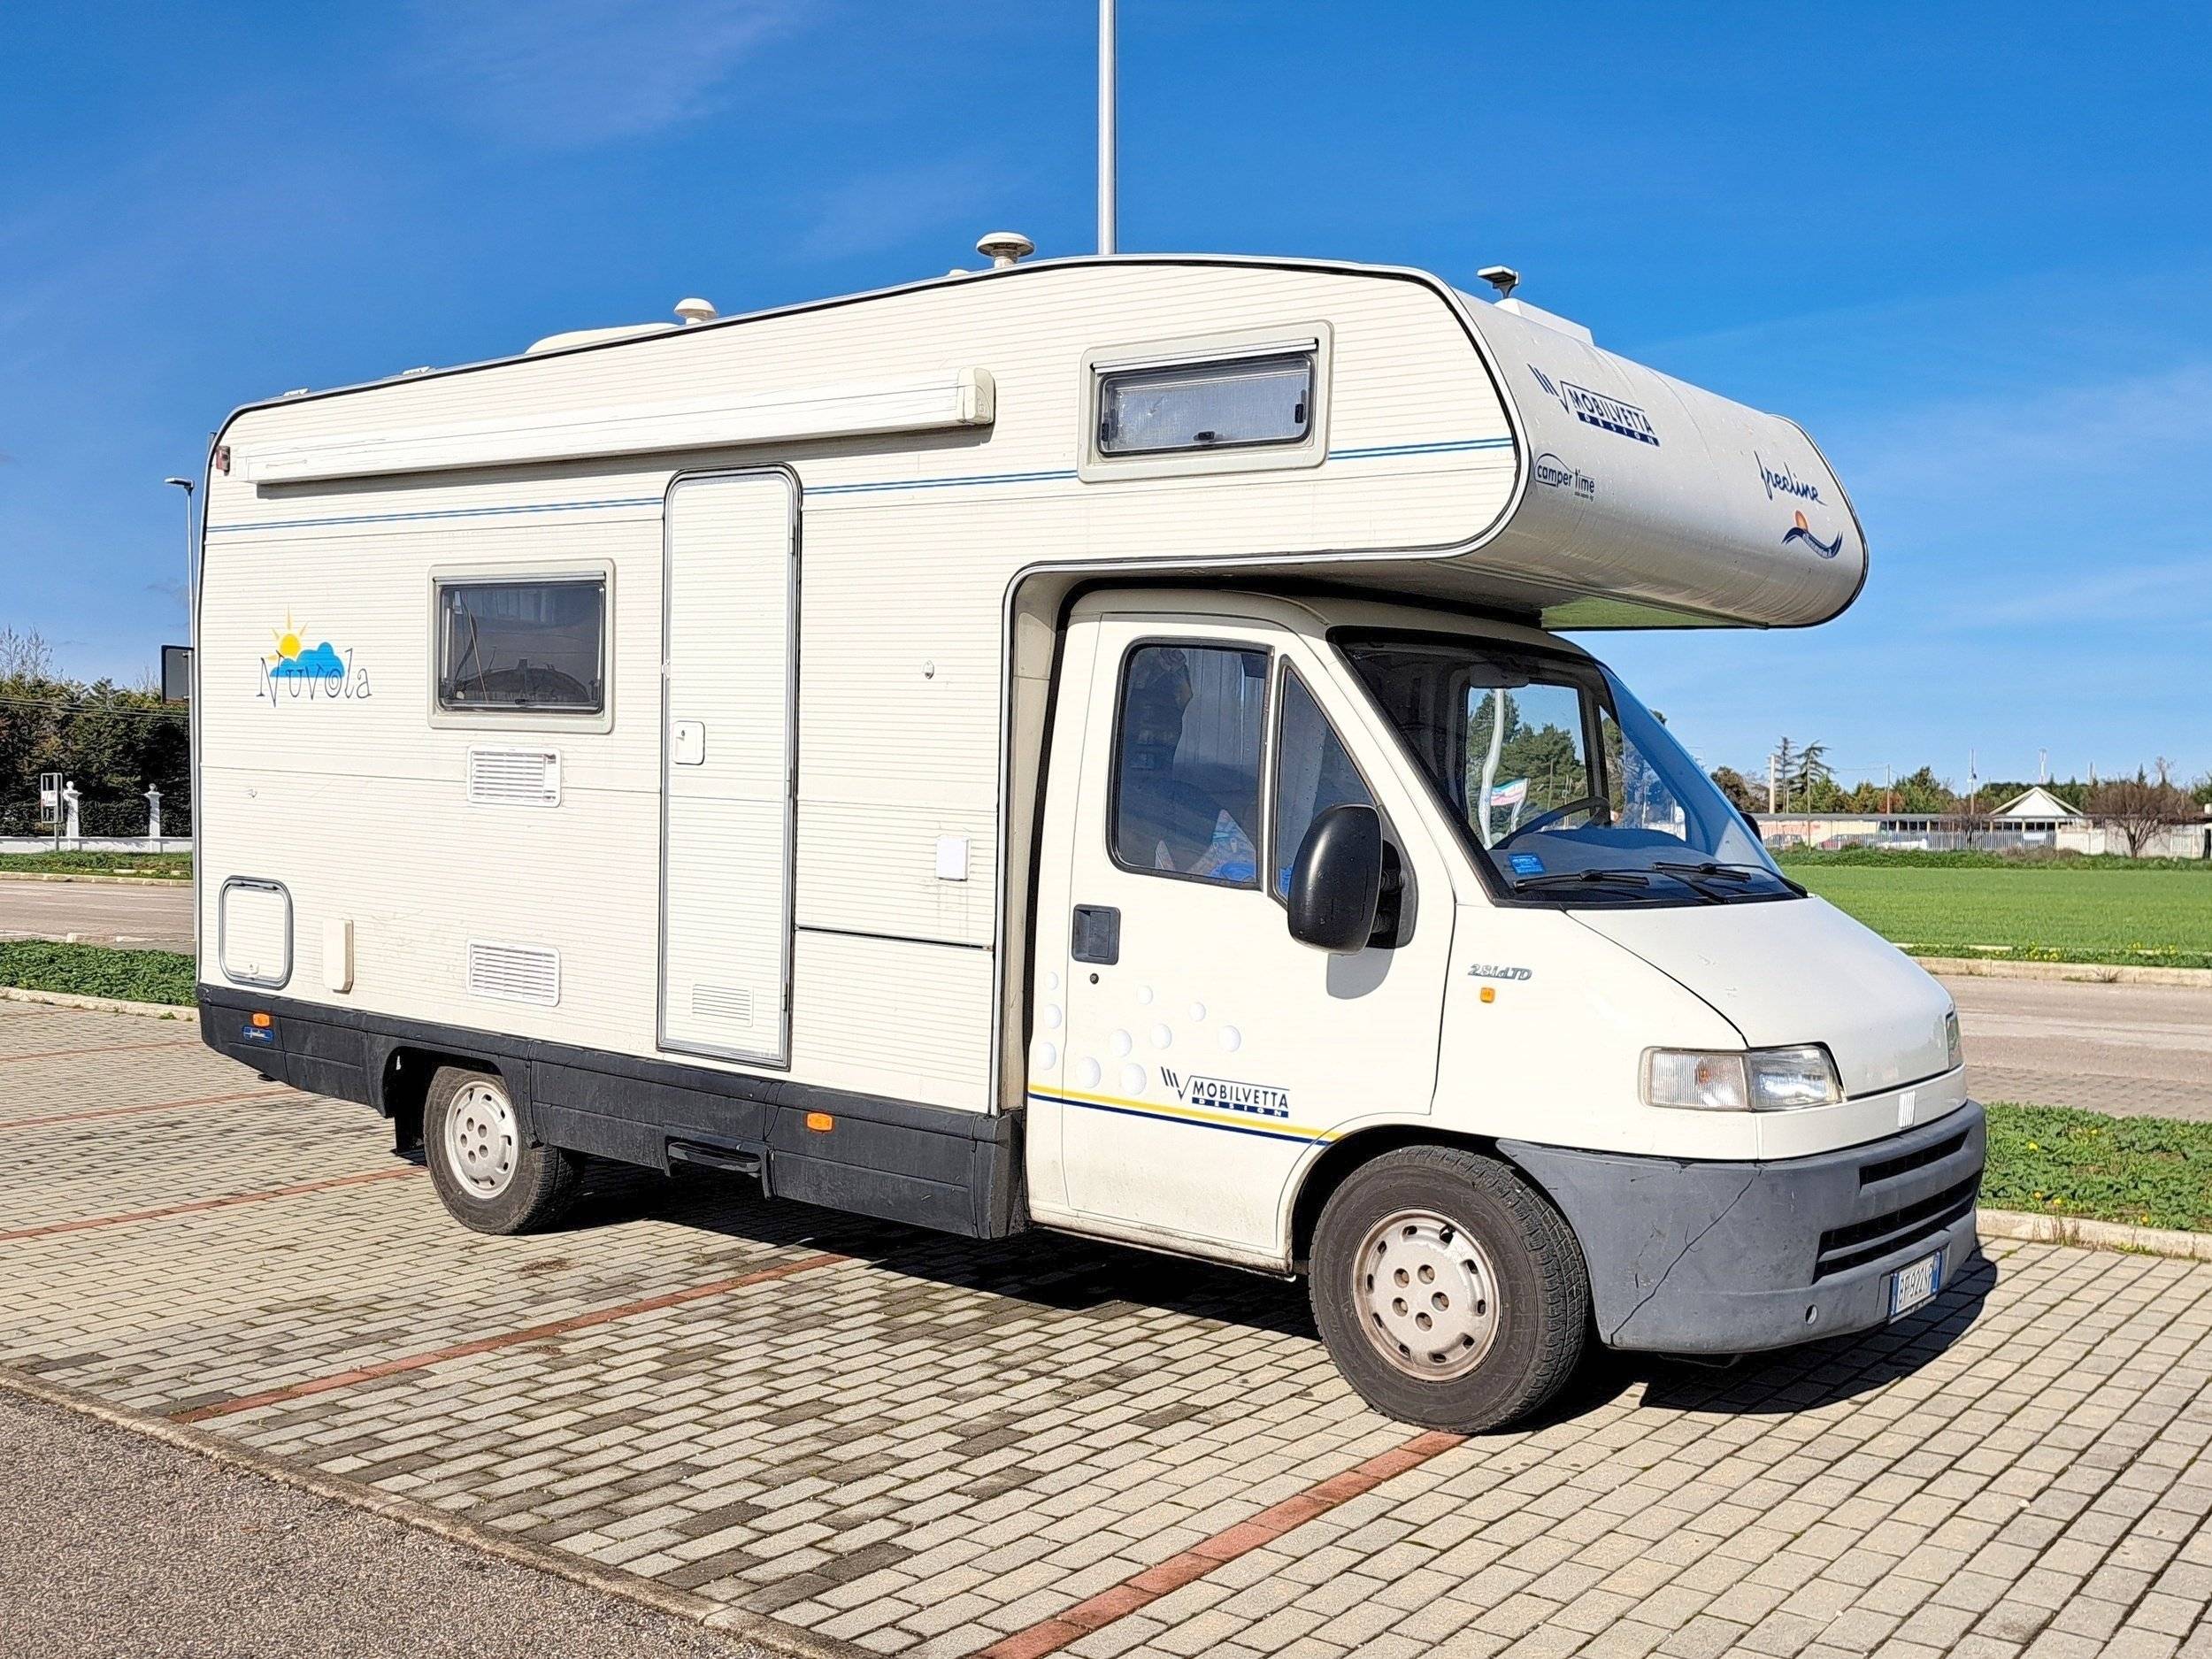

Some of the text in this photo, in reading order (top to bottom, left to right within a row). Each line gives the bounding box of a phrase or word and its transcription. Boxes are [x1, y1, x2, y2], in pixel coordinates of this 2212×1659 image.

[1567, 388, 1655, 435] MOBILVETTA
[1537, 465, 1572, 488] camper
[1193, 1080, 1289, 1109] MOBILVETTA
[1197, 1098, 1283, 1117] DESIGN
